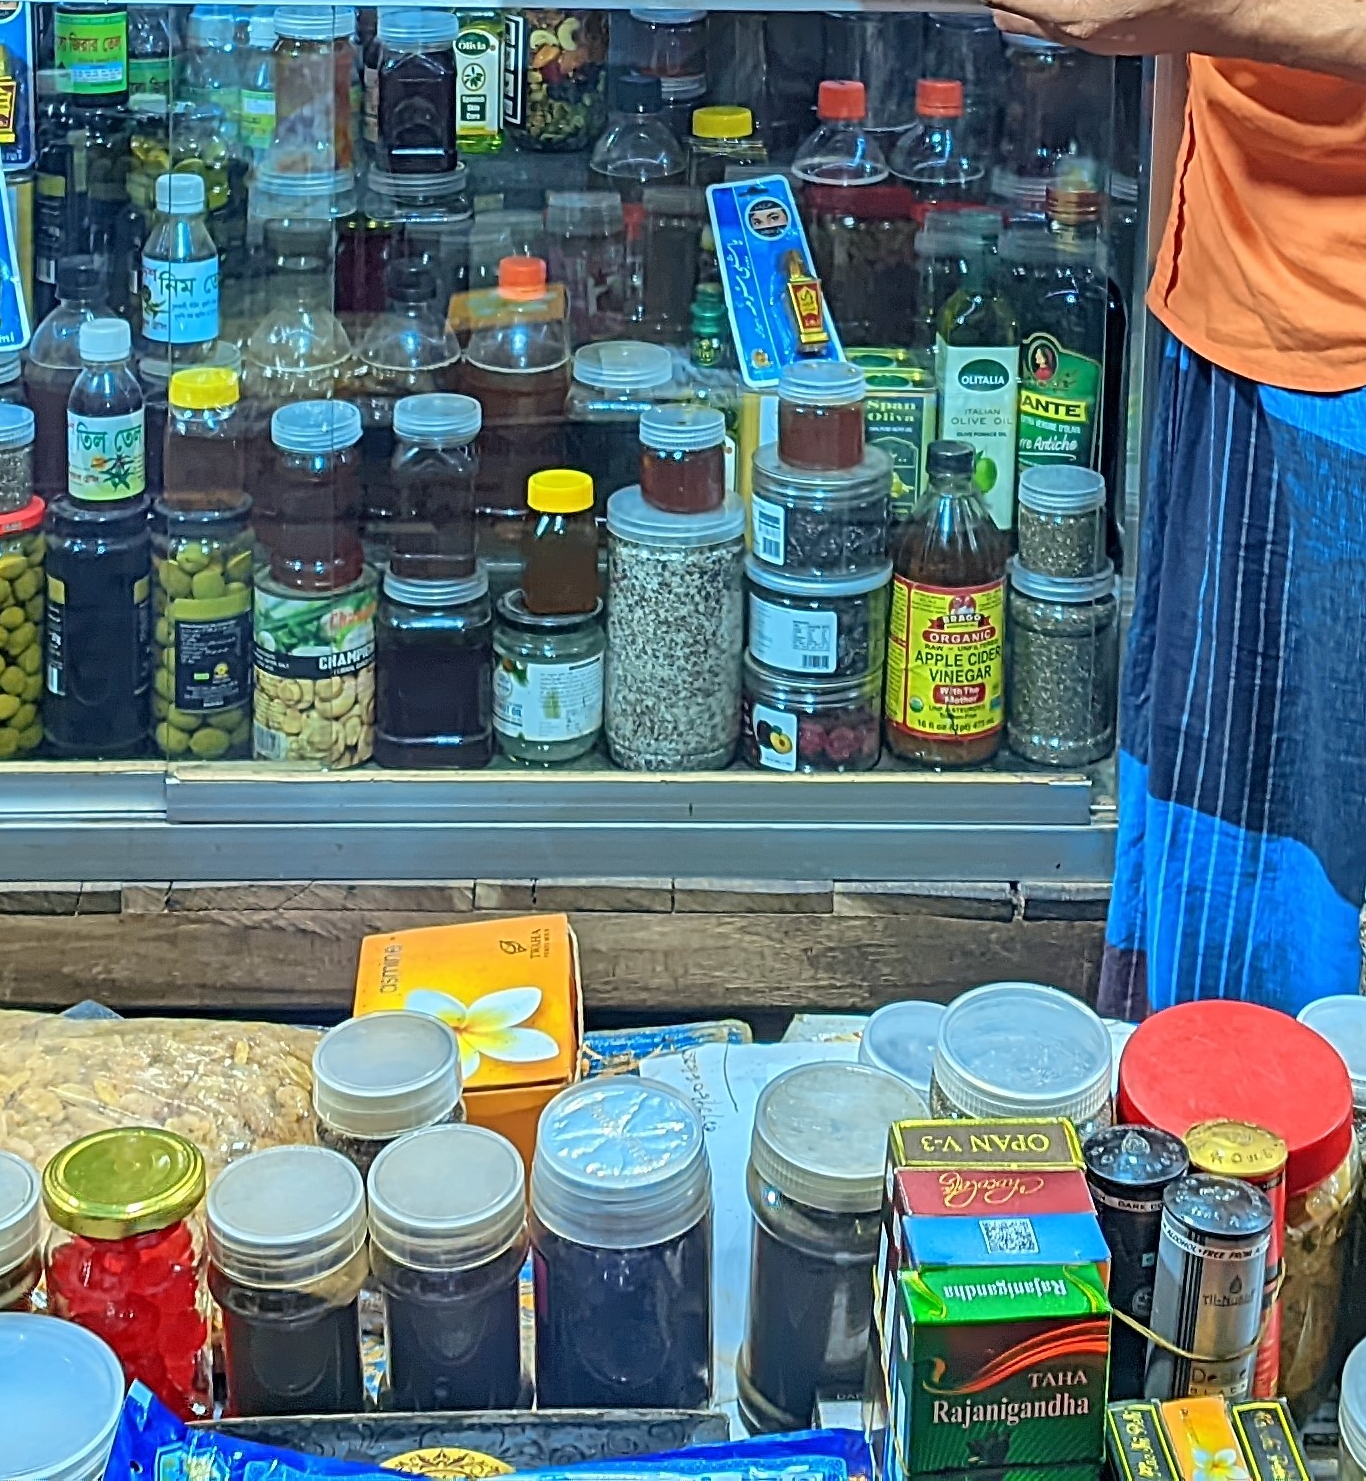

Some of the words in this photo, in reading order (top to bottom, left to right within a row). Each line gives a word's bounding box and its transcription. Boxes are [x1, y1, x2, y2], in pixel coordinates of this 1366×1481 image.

[158, 272, 196, 299] নিম
[961, 375, 1005, 386] OLITALIA
[866, 399, 916, 412] Span
[1022, 393, 1081, 417] ANTE
[951, 417, 987, 425] OLIVE
[993, 417, 1012, 425] OIL
[75, 422, 107, 456] তিল
[943, 614, 981, 623] BRAGG
[930, 630, 991, 643] ORGANIC
[925, 643, 943, 651] RAW
[915, 650, 963, 667] APPLE
[968, 646, 1001, 665] CIDER
[929, 665, 991, 683] VINEGAR
[964, 686, 980, 694] The
[920, 1135, 962, 1153] V-3
[970, 1134, 1050, 1153] OPAN
[1118, 1200, 1147, 1211] DARK
[943, 1278, 1067, 1302] Rajanigandha
[1028, 1370, 1088, 1388] TAHA
[933, 1392, 1090, 1429] Rajanigandha
